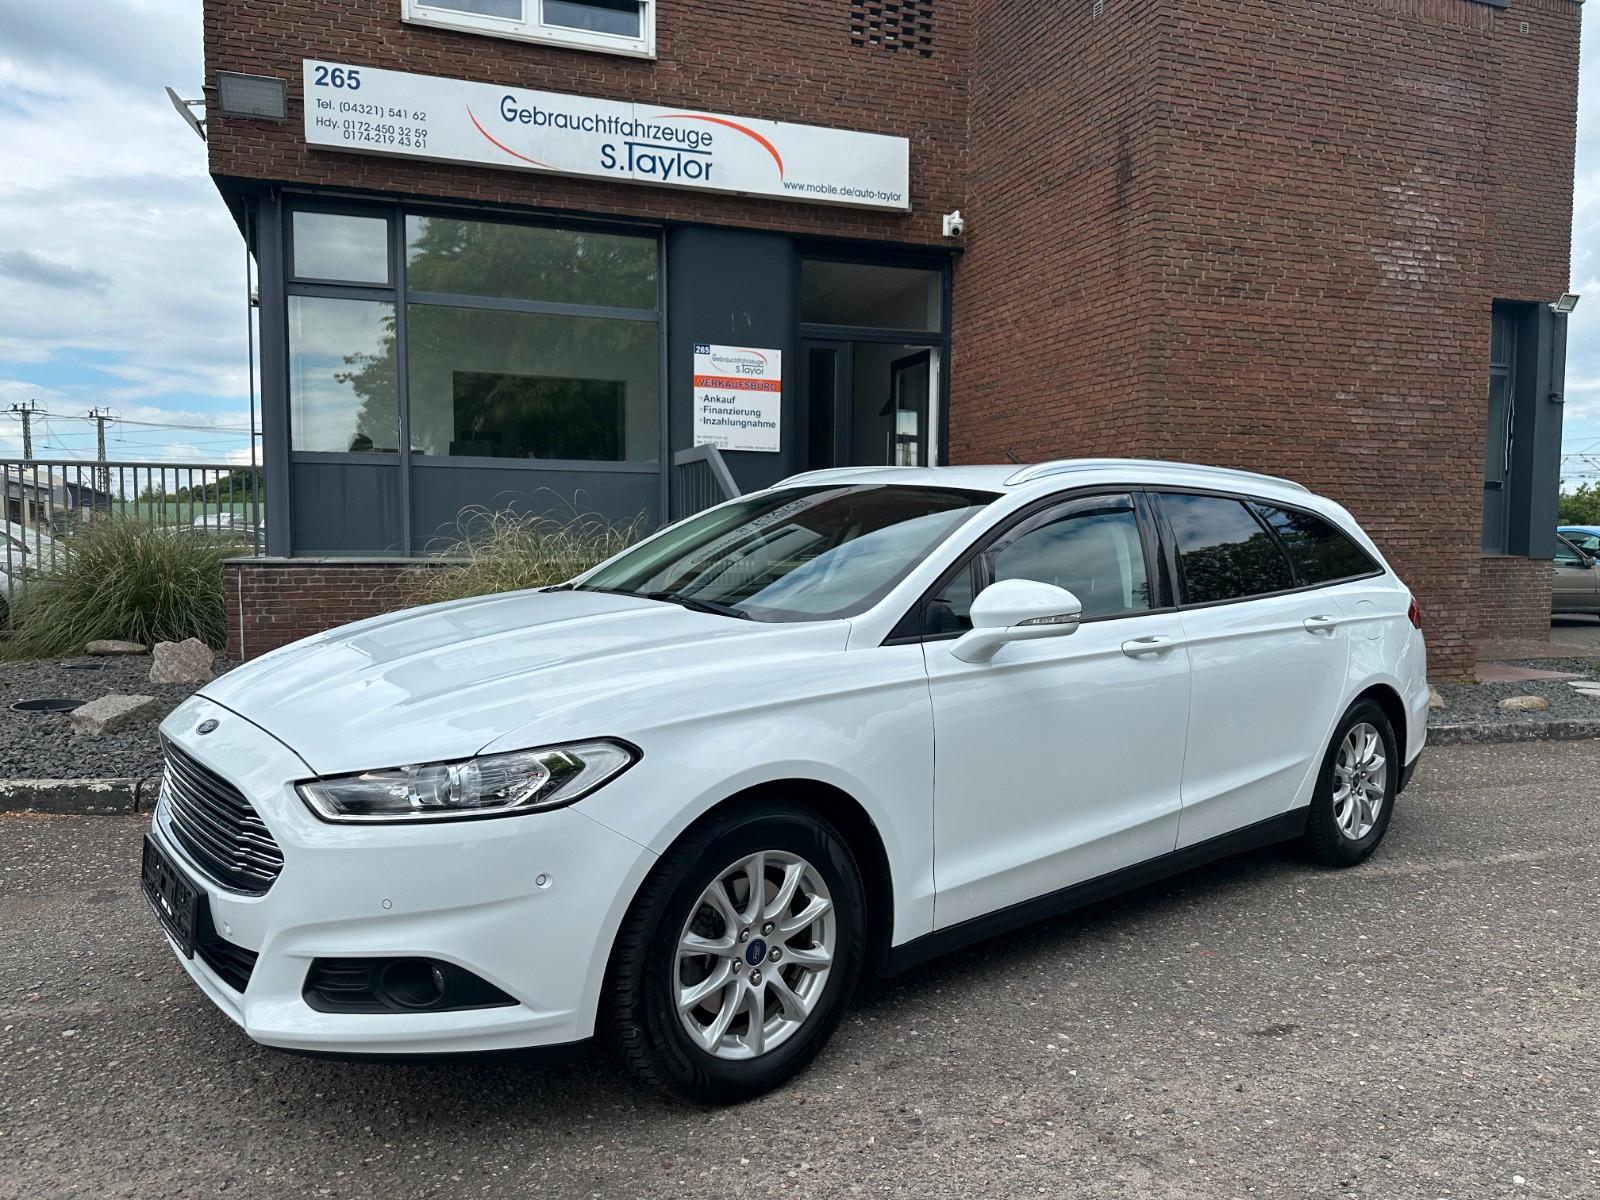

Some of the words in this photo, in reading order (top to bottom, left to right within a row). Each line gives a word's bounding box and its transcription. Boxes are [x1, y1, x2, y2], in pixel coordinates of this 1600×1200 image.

[314, 65, 360, 90] 265
[316, 98, 335, 110] Tel.
[339, 102, 384, 118] (04321)
[388, 108, 407, 119] 541
[412, 111, 427, 121] 62
[316, 116, 340, 130] Hdy.
[343, 119, 395, 134] 0172-450
[398, 126, 411, 137] 32
[414, 128, 428, 139] 59
[500, 95, 713, 149] Gebrauchtfahrzeuge
[343, 130, 395, 145] 0174-219
[398, 136, 411, 147] 43
[414, 138, 426, 149] 61
[600, 141, 713, 181] S.Taylor
[783, 181, 901, 202] www.mobile.de/auto-taylor
[695, 345, 710, 354] 265
[703, 394, 736, 404] Ankauf
[703, 405, 762, 418] Finanzierung
[703, 416, 776, 429] Inzahlungnahme
